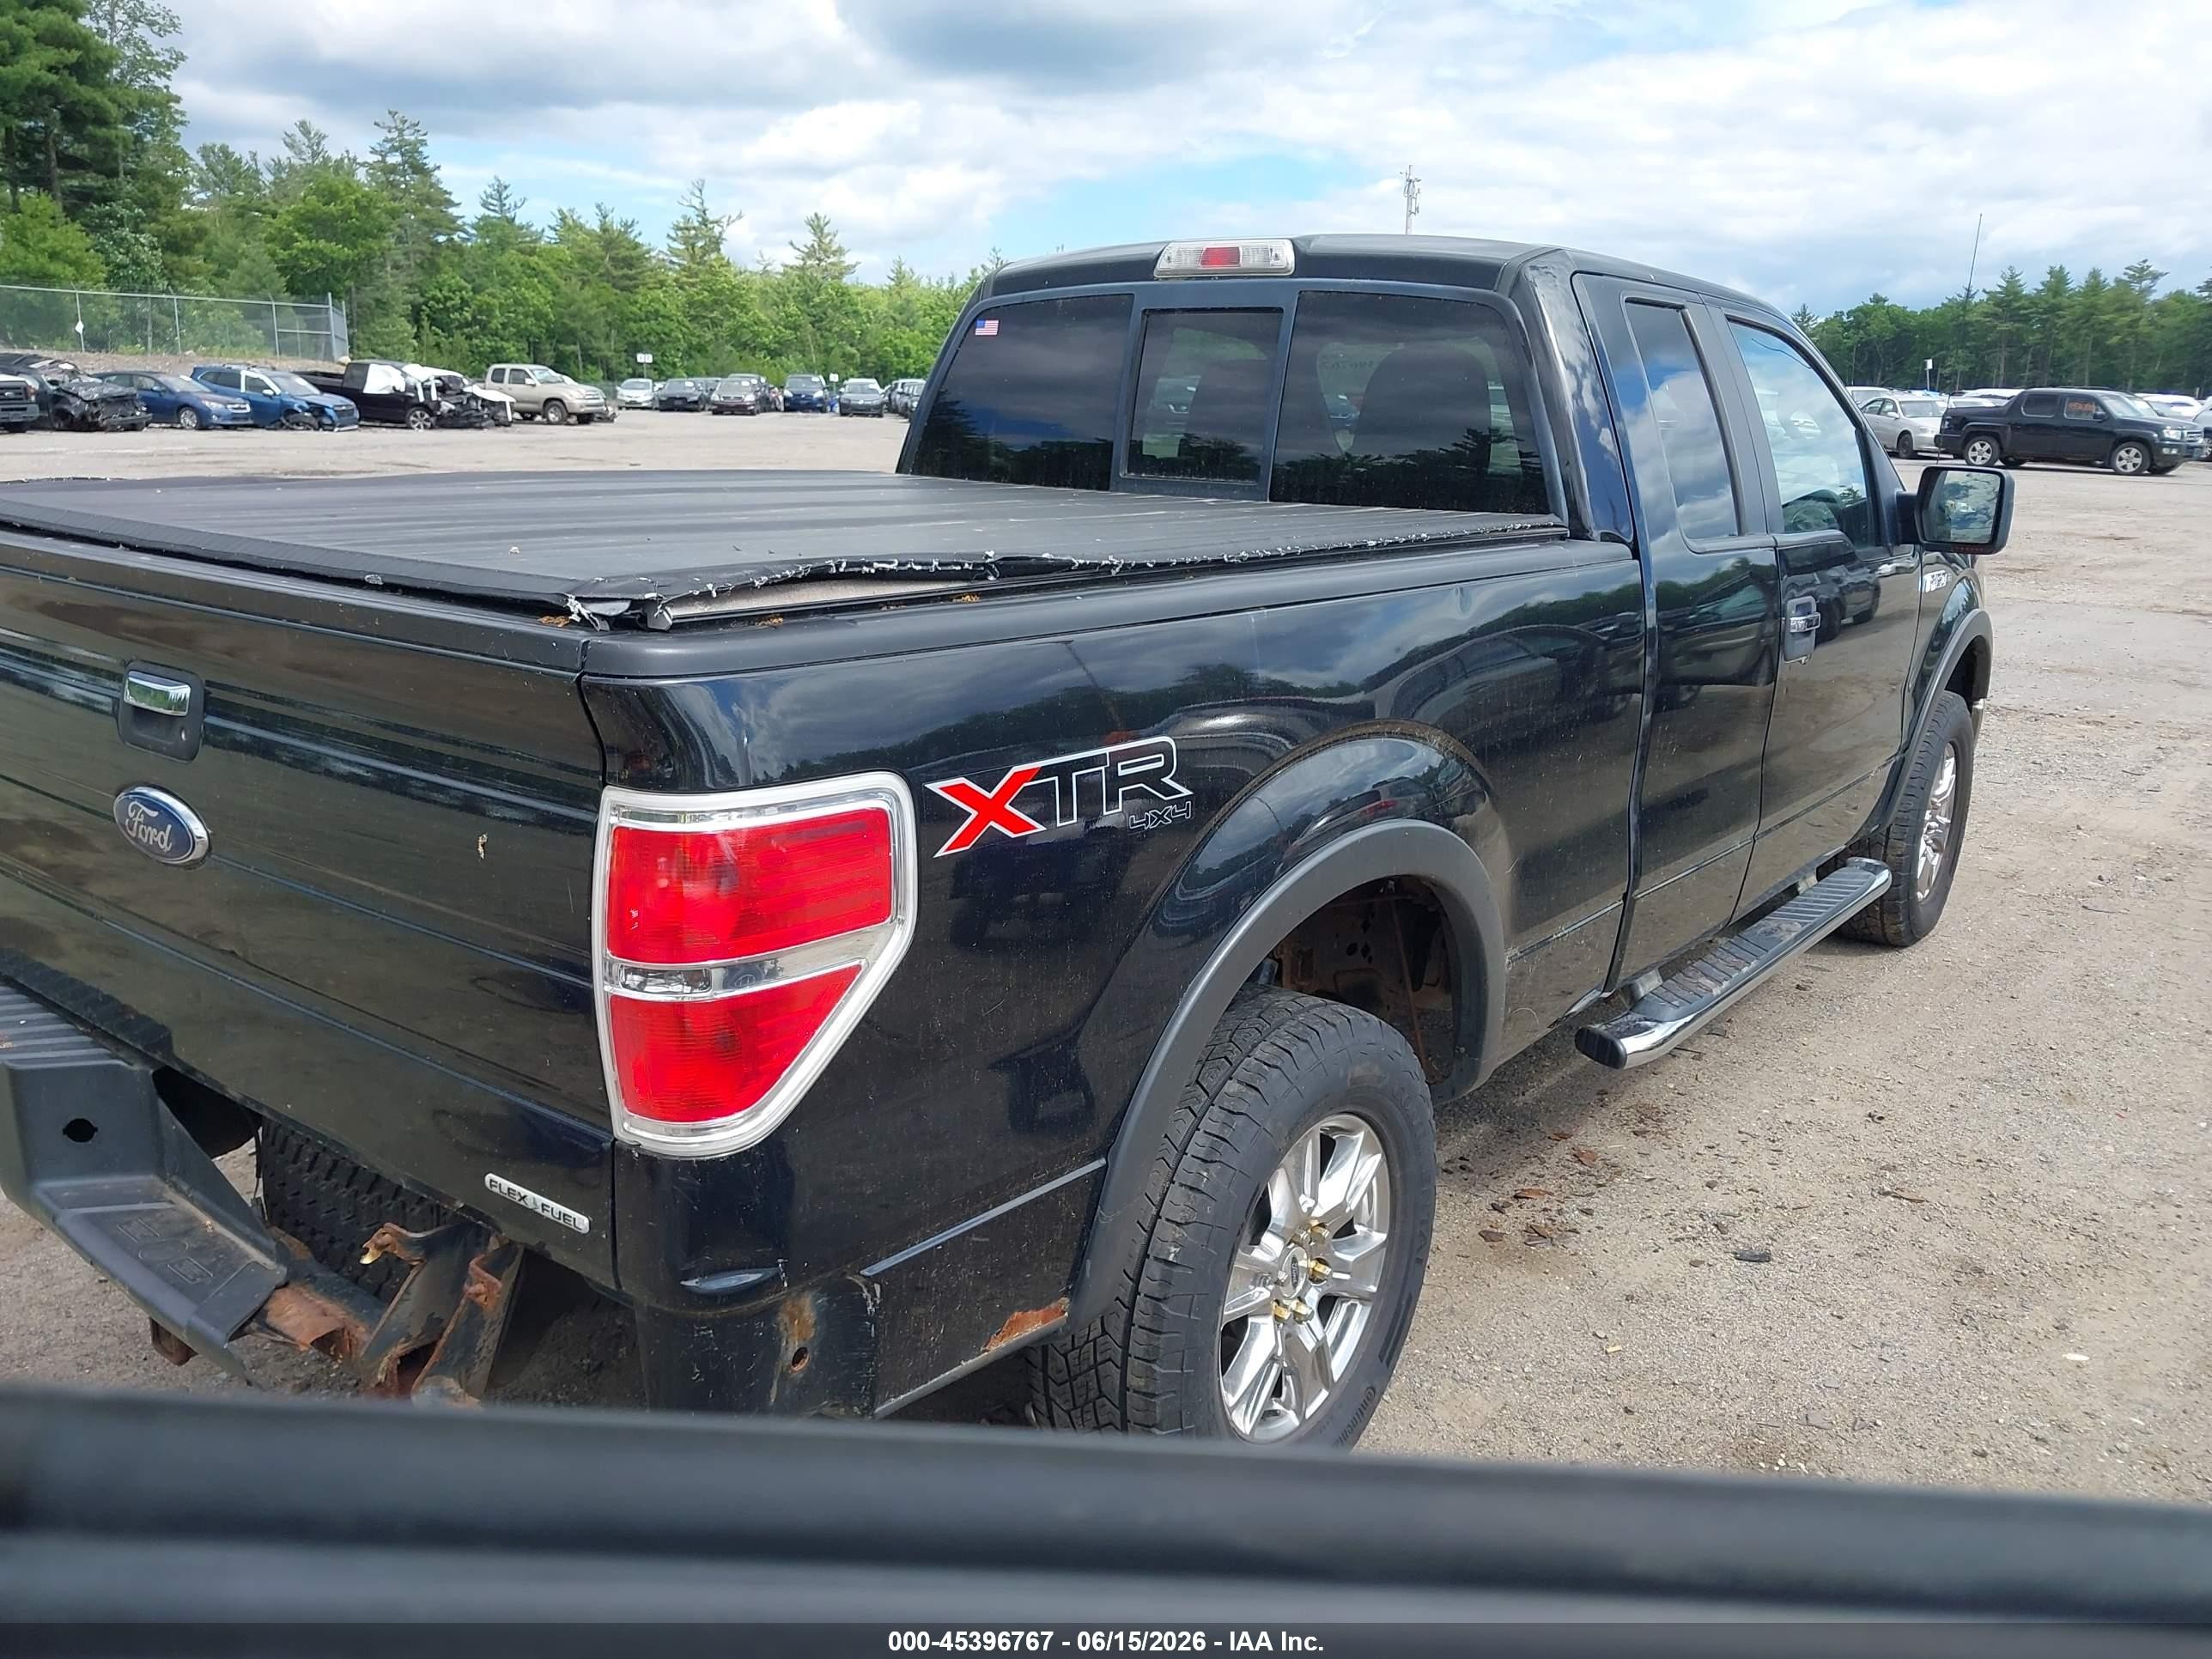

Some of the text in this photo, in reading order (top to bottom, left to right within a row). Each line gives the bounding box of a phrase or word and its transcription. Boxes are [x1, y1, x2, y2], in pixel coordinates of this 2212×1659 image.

[924, 736, 1194, 858] XTR
[125, 801, 172, 852] Ford
[489, 1179, 583, 1231] FLEX FUEL
